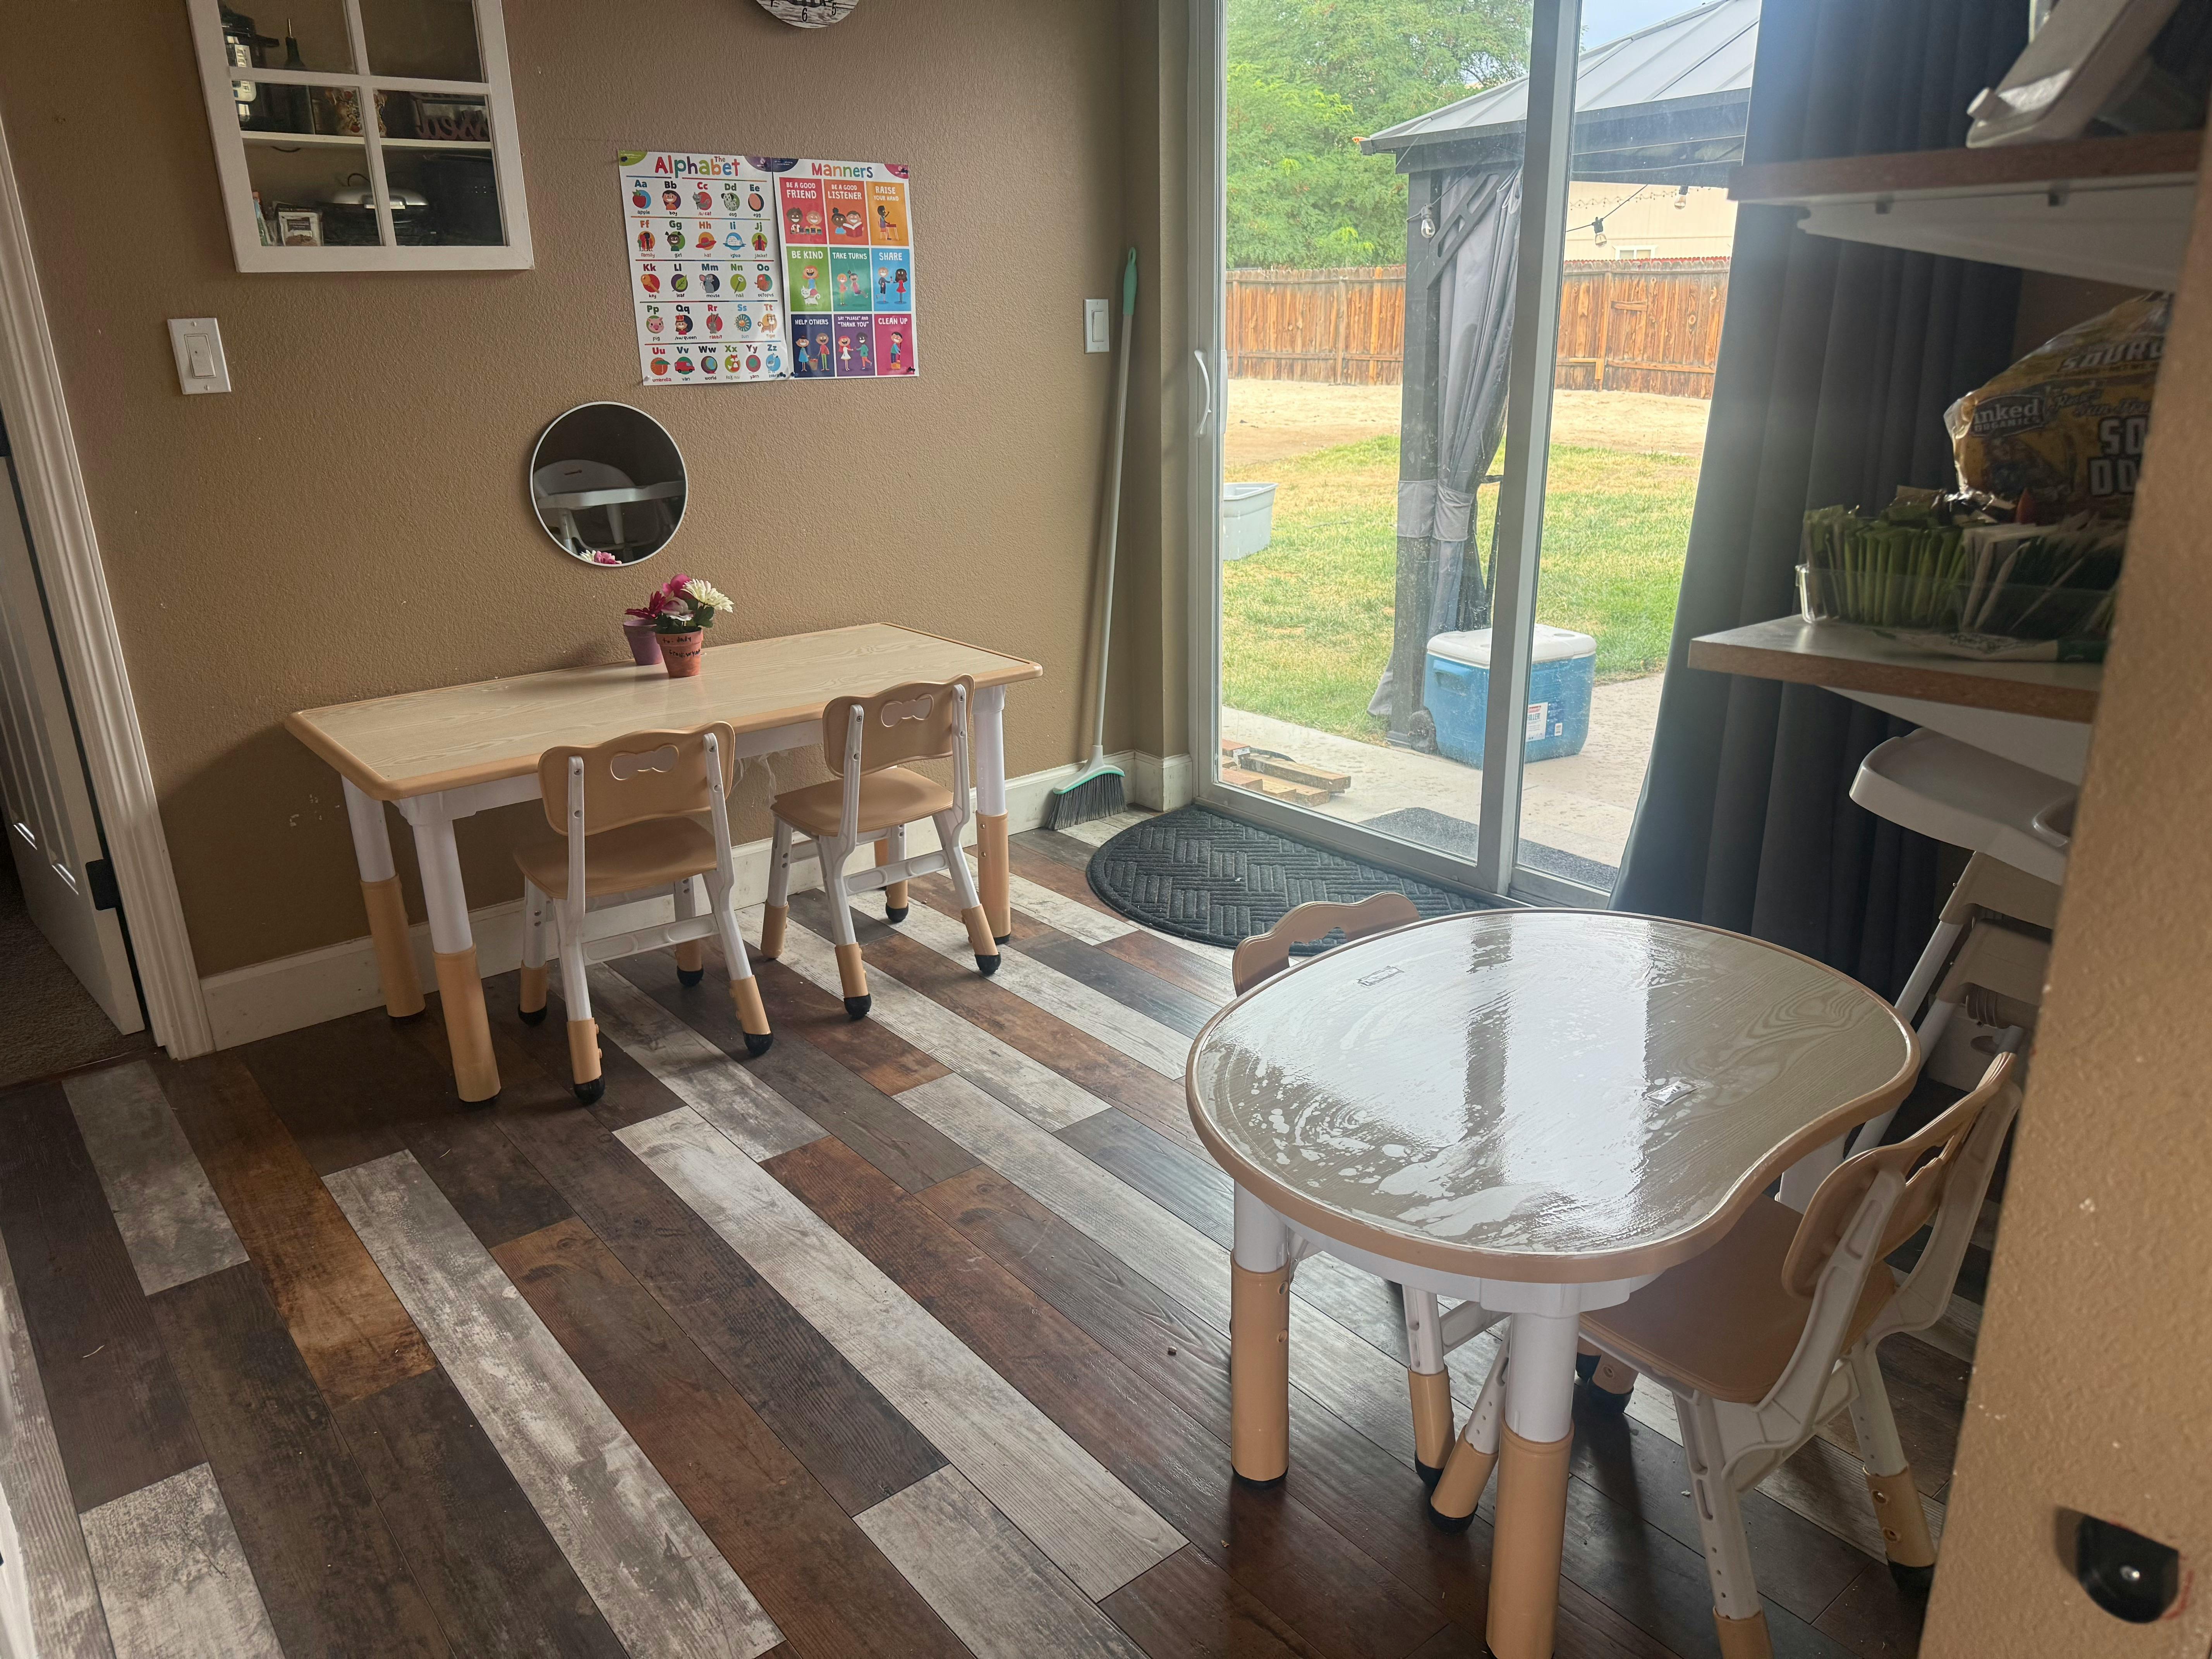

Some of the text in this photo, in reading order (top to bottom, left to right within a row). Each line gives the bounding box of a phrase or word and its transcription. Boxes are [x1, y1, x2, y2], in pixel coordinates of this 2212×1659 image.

[832, 2, 837, 15] 5
[802, 7, 807, 22] 6
[655, 155, 740, 178] Alphabet
[812, 163, 873, 179] Manners
[634, 179, 647, 188] Aa
[664, 180, 677, 189] Bb
[697, 182, 708, 190] Cc
[725, 183, 737, 191] Dd
[786, 190, 816, 199] FRIEND
[875, 186, 896, 194] RAISE
[828, 191, 862, 200] LISTENER
[640, 220, 650, 228] Ff
[669, 220, 682, 230] Gg
[699, 221, 712, 230] Hh
[755, 222, 763, 232] Jj
[792, 251, 823, 259] BE KIND
[879, 252, 902, 261] SHARE
[643, 263, 656, 271] Kk
[647, 305, 659, 314] Pp
[676, 304, 690, 314] Qq
[652, 347, 666, 355] Uu
[746, 344, 758, 354] Yy
[1974, 417, 2041, 433] ORGANICS
